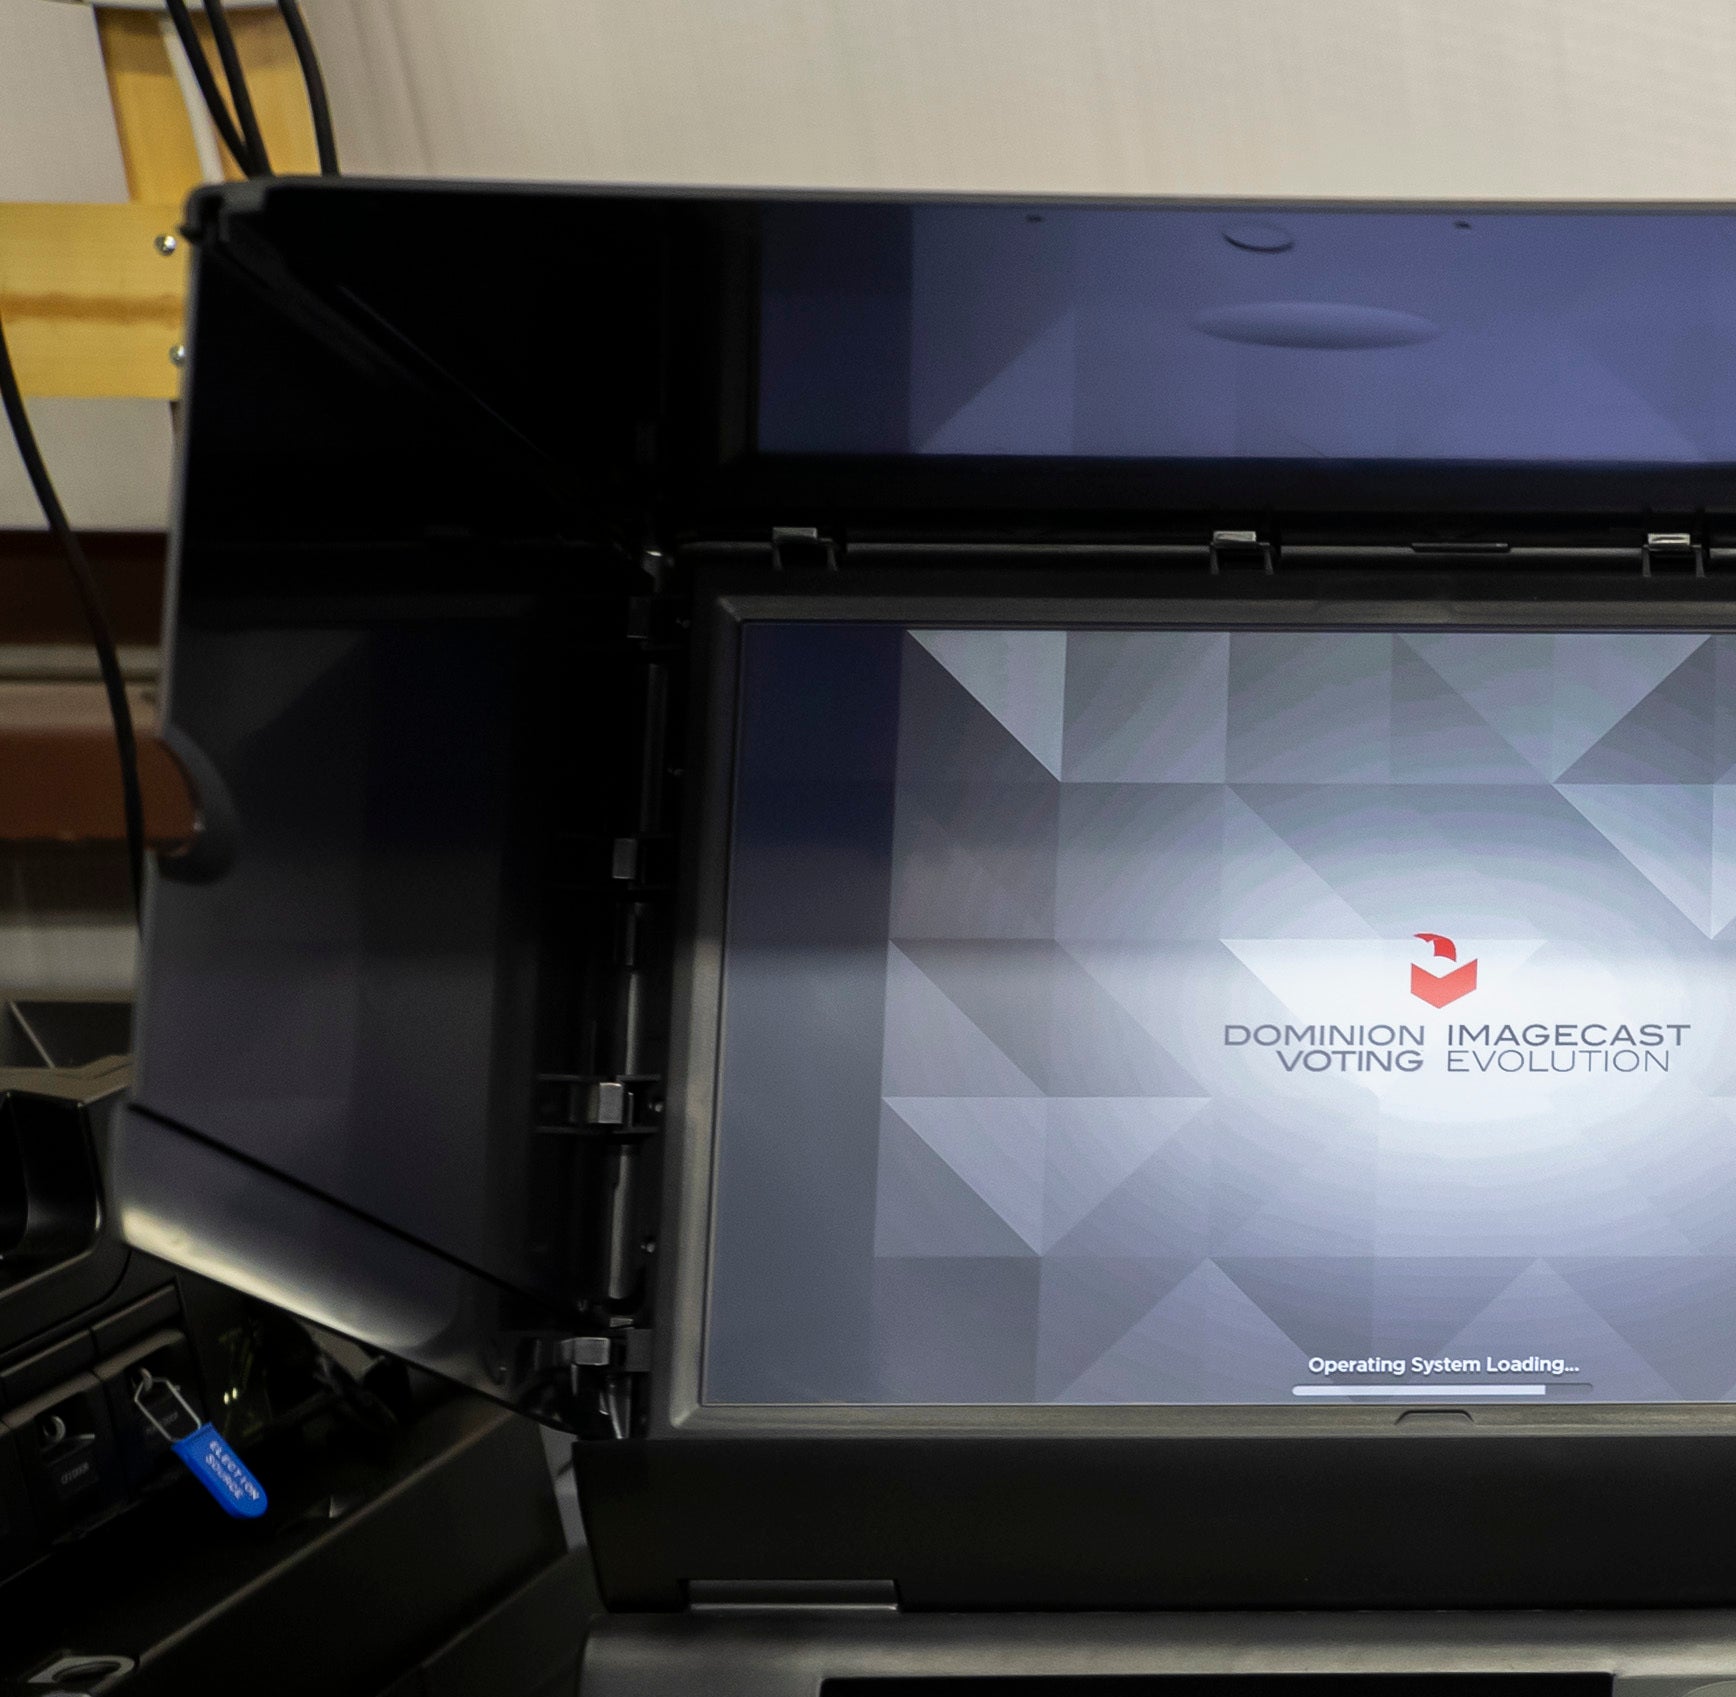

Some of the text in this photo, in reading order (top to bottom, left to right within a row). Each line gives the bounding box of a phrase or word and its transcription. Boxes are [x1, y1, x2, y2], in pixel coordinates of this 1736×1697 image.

[1224, 1024, 1692, 1047] DOMINION IMAGECAST
[1275, 1050, 1670, 1073] VOTING EVOLUTION
[1308, 1356, 1580, 1375] Operating System Loading...
